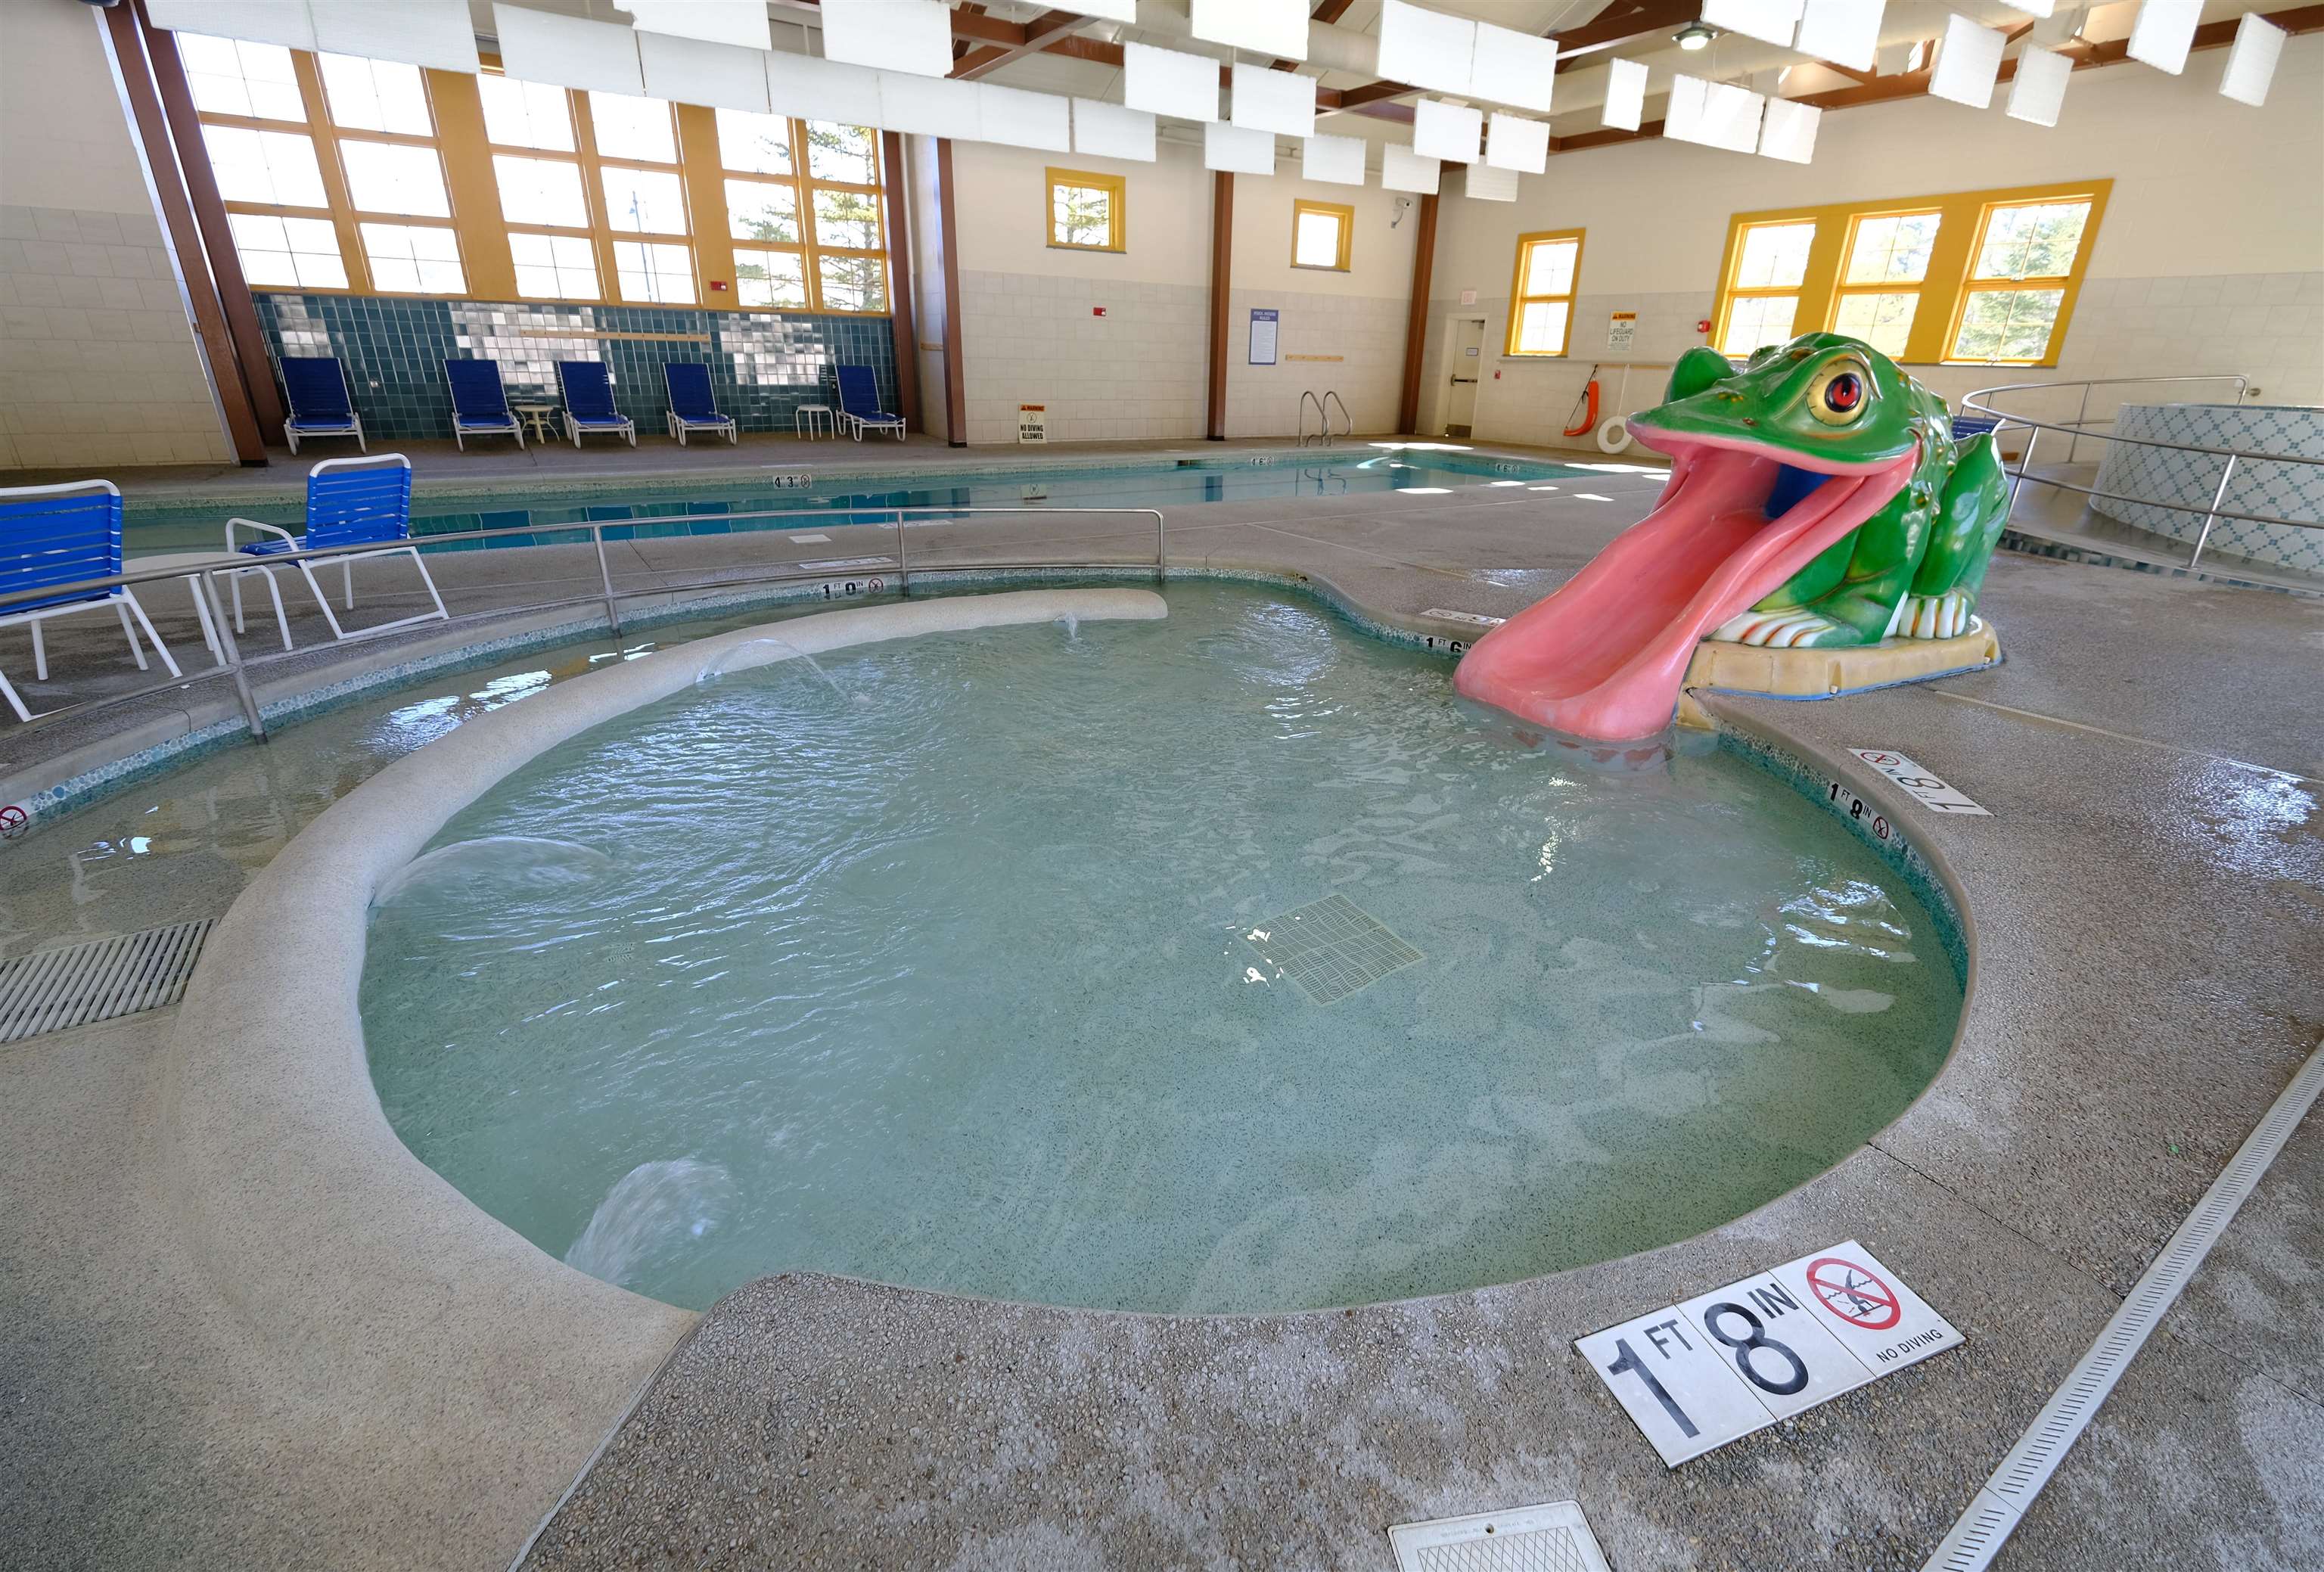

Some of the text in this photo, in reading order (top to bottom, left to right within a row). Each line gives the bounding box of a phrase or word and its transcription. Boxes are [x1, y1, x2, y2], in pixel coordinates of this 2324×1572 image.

[787, 477, 794, 488] 3
[823, 584, 830, 595] 1
[1426, 637, 1434, 648] 1
[1449, 642, 1462, 653] 6
[1897, 777, 1946, 789] 8
[1831, 783, 1872, 820] 1 FT 8 IN
[1876, 1328, 1943, 1363] NO DIVING
[1607, 1282, 1809, 1438] 1 FT 8 IN
